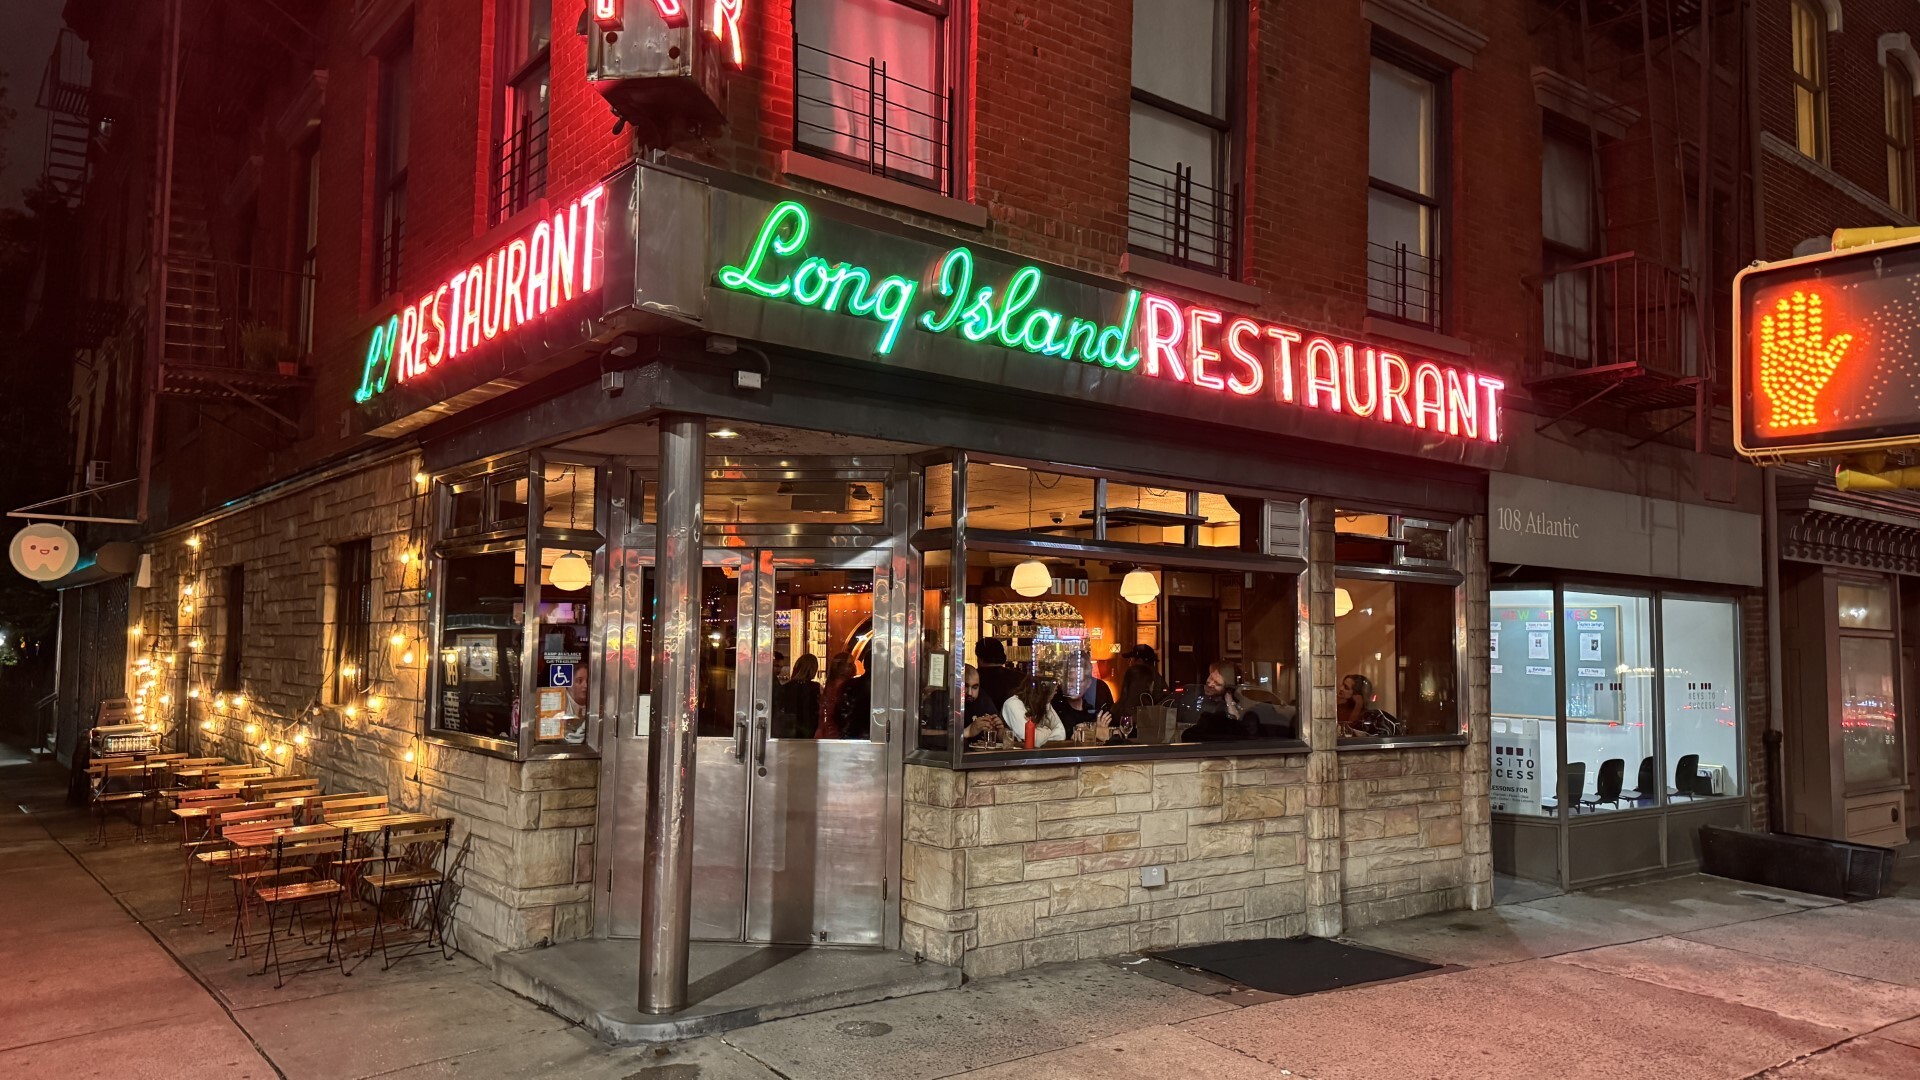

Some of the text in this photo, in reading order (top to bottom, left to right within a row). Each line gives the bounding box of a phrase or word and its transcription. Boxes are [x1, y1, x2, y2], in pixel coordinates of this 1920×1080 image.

[397, 181, 604, 384] RESTAURANT
[718, 200, 1505, 443] Long Island RESTAURANT
[1525, 511, 1580, 539] Atlantic
[1053, 578, 1088, 595] 110
[1538, 609, 1553, 620] AT
[1565, 609, 1598, 620] KEYS
[1516, 759, 1535, 768] TO
